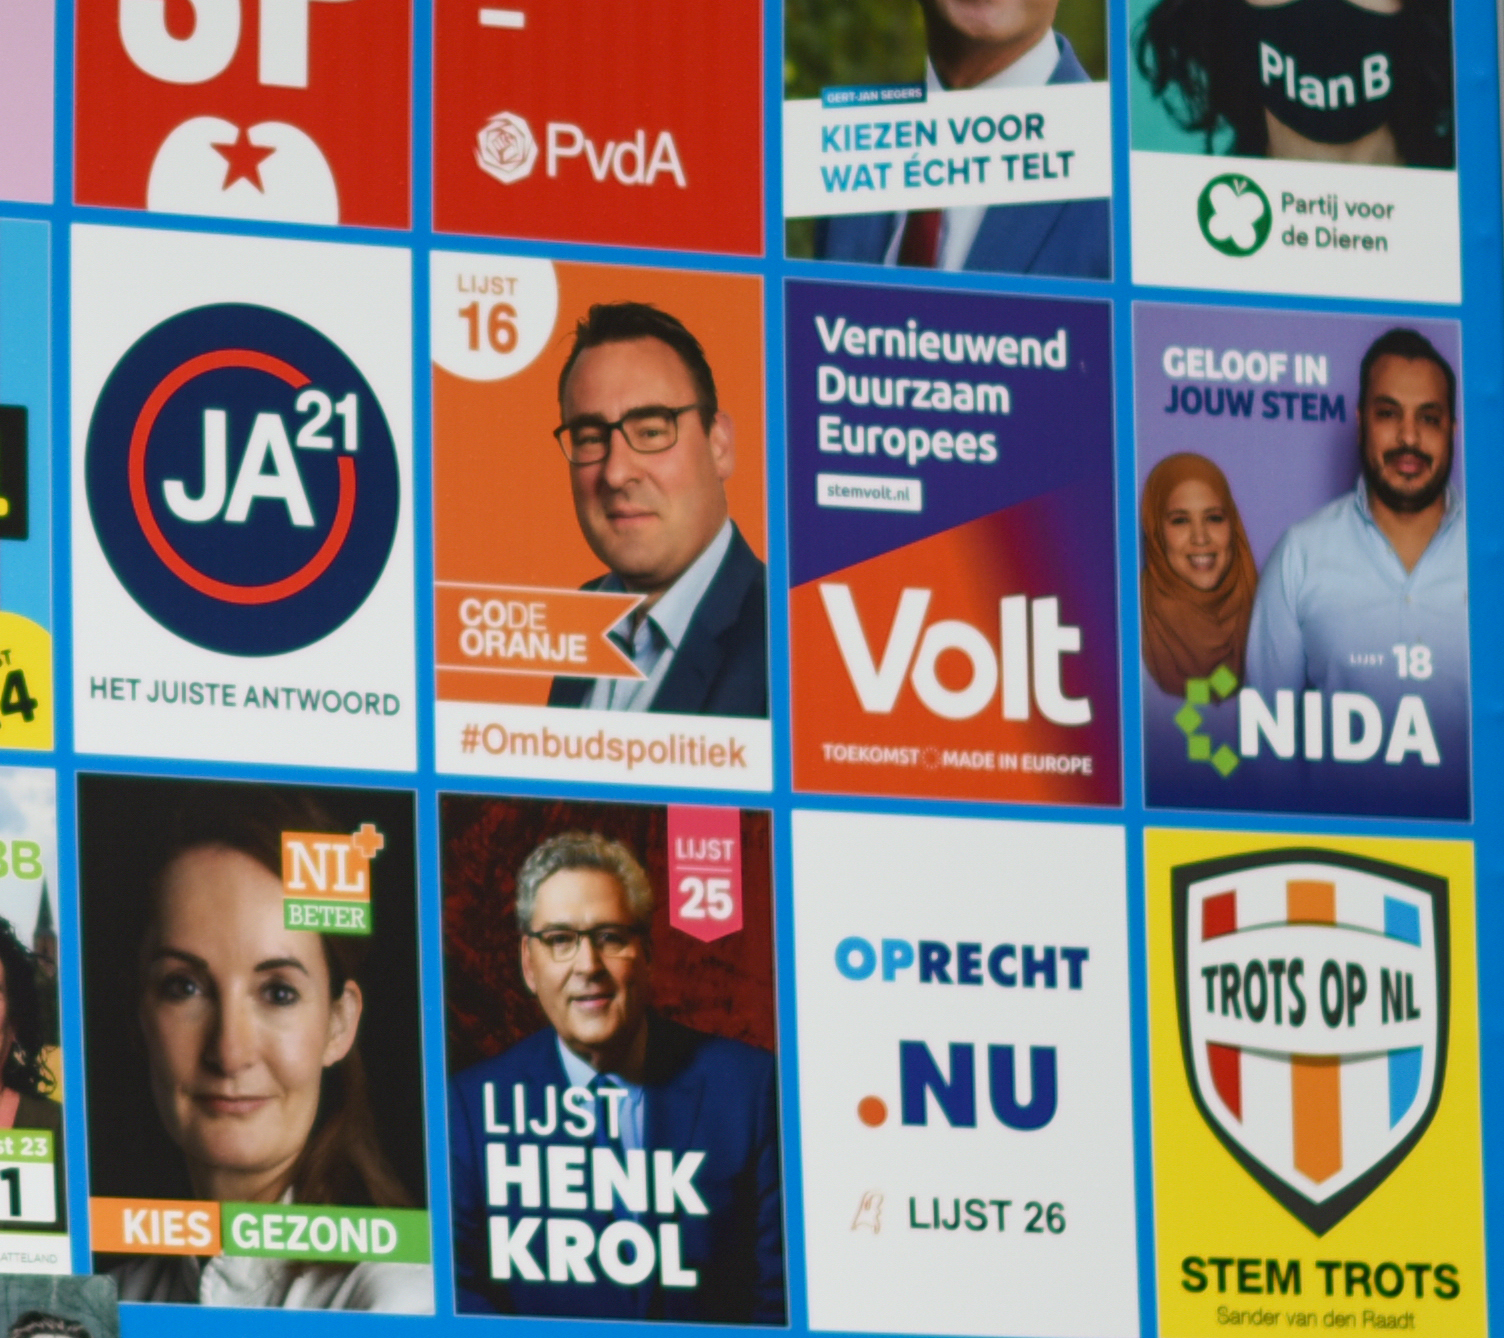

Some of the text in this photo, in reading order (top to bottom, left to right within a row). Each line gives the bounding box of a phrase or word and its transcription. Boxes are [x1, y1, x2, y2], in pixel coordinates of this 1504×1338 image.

[1259, 41, 1392, 112] Plan B
[546, 122, 687, 189] PvdA
[821, 112, 1045, 152] KIEZEN VOOR
[820, 150, 1075, 193] WAT ÉCHT TELT
[1280, 192, 1395, 221] Partij voor
[1281, 226, 1389, 253] de Dieren
[815, 315, 1068, 369] Vernieuwend
[1163, 347, 1328, 385] GELOOF IN
[818, 366, 1011, 414] Duurzaam
[1164, 385, 1347, 423] JOUW STEM
[817, 416, 999, 466] Europees
[827, 483, 910, 504] stemvolt.nl
[459, 597, 547, 631] CODE
[460, 629, 588, 663] ORANJE
[818, 583, 1092, 726] Volt
[89, 676, 401, 717] HET JUISTE ANTWOORD
[461, 723, 748, 771] #Ombudspolitiek
[1239, 688, 1440, 766] NIDA
[822, 743, 1093, 775] TOEKOMST MADE IN EUROPE
[834, 935, 1091, 991] OPRECHT
[1201, 957, 1421, 1029] TROTS OP NL
[483, 1082, 629, 1139] LIJST
[486, 1143, 710, 1216] HENK
[122, 1208, 398, 1256] KIES GEZOND
[488, 1216, 698, 1288] KROL
[1180, 1256, 1461, 1301] STEM TROTS
[1216, 1306, 1416, 1331] Sander van den Raadt
